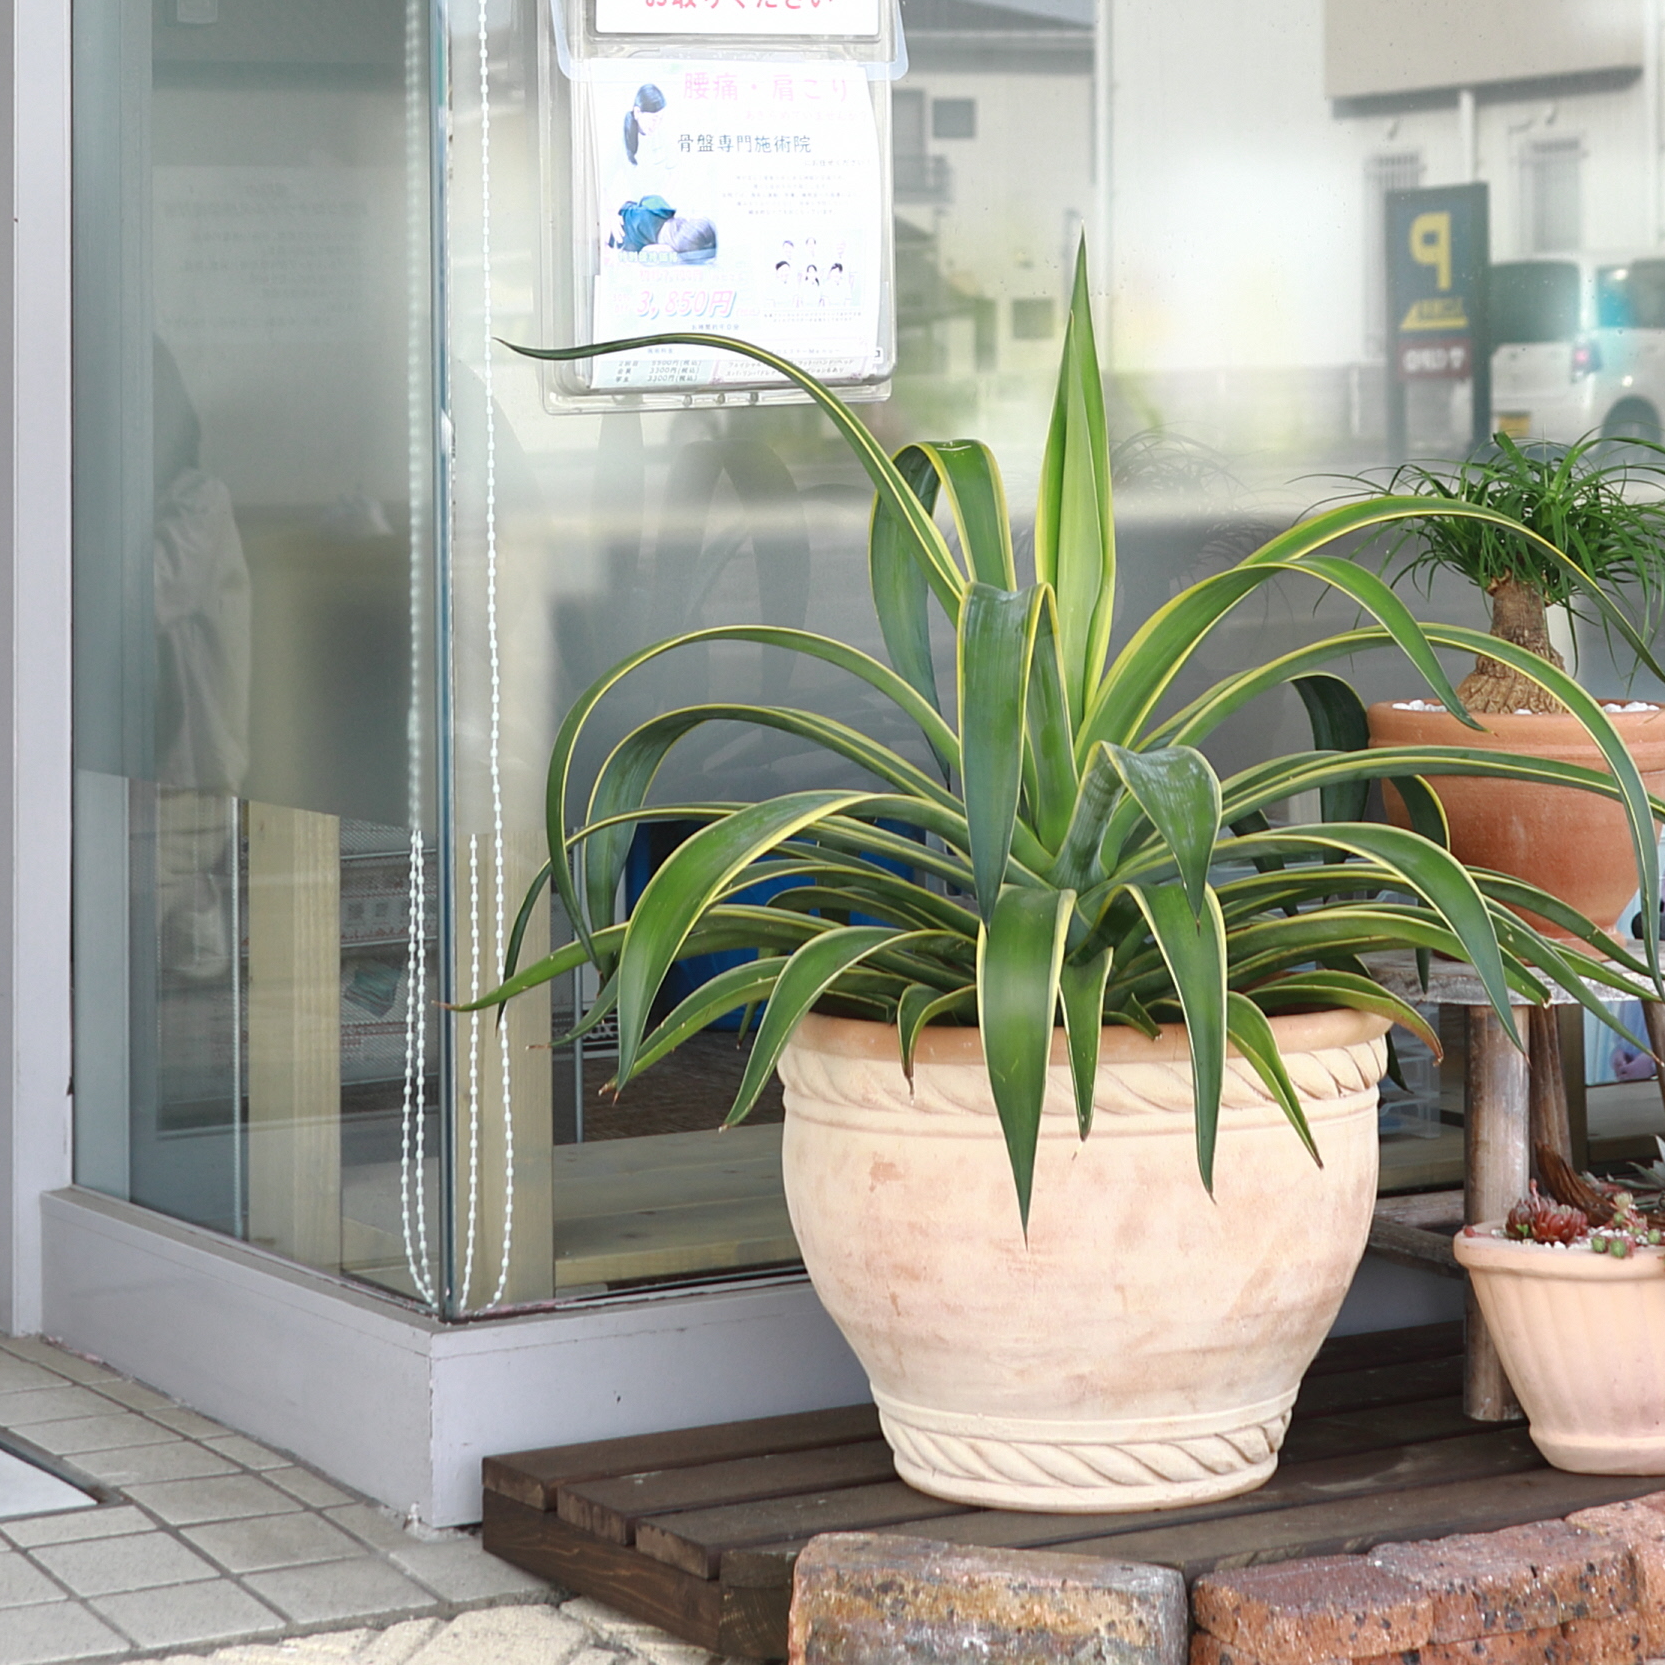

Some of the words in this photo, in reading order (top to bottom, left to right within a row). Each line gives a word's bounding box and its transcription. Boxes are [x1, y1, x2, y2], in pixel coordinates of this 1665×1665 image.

[683, 71, 848, 103] 腰痛・肩こり
[677, 133, 813, 154] 骨盤専門施術院
